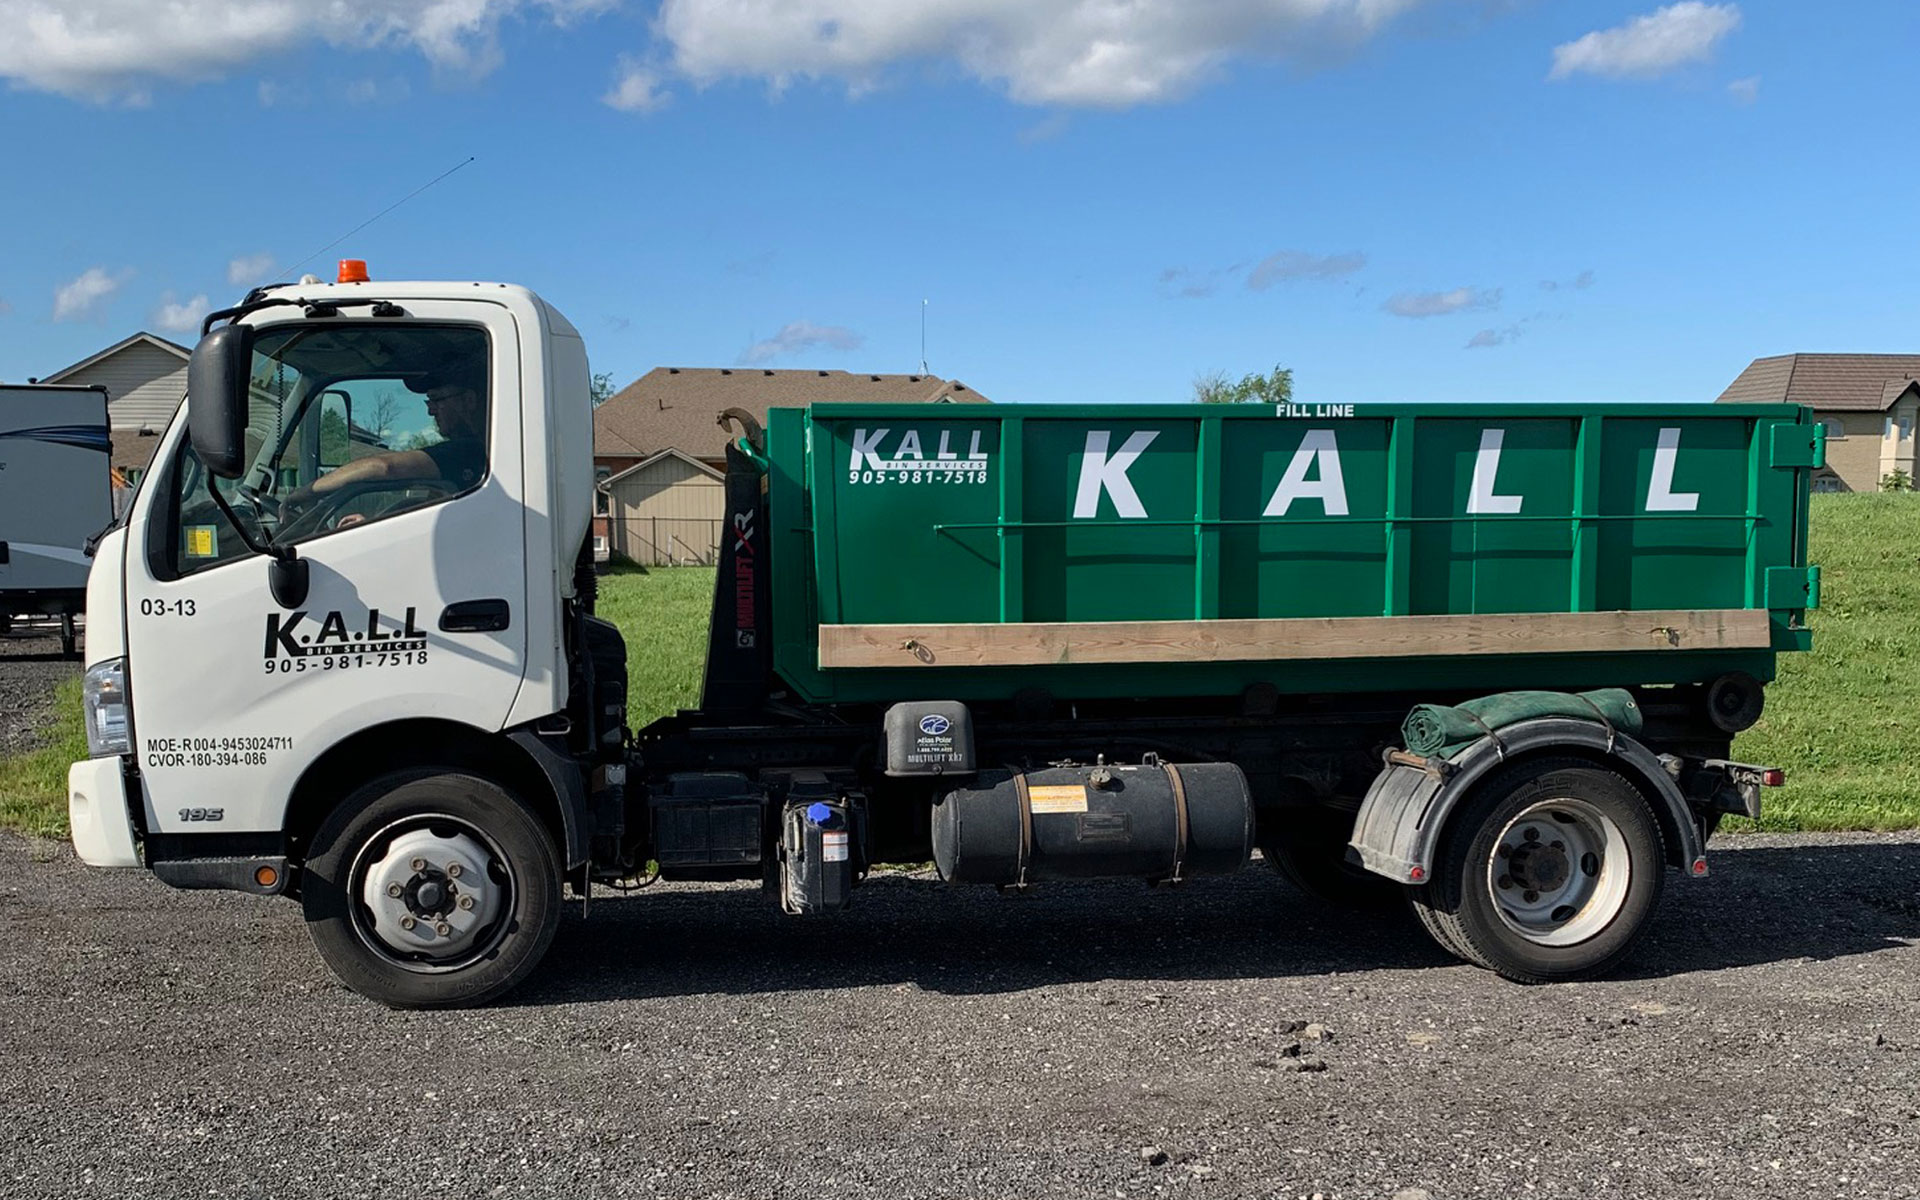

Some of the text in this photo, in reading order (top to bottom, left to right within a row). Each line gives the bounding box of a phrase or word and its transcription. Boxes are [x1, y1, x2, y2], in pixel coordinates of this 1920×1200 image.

[1276, 404, 1354, 417] FILL LINE
[849, 429, 988, 471] KALL
[849, 471, 987, 484] 905-981-7518
[733, 508, 754, 555] XR
[140, 598, 196, 617] 03-13
[264, 607, 427, 659] K.A.L.L
[306, 641, 423, 655] BIN SERVICES
[265, 651, 428, 674] 905-981-7518
[148, 752, 267, 767] CVOR-180-394-086
[178, 808, 224, 822] 195
